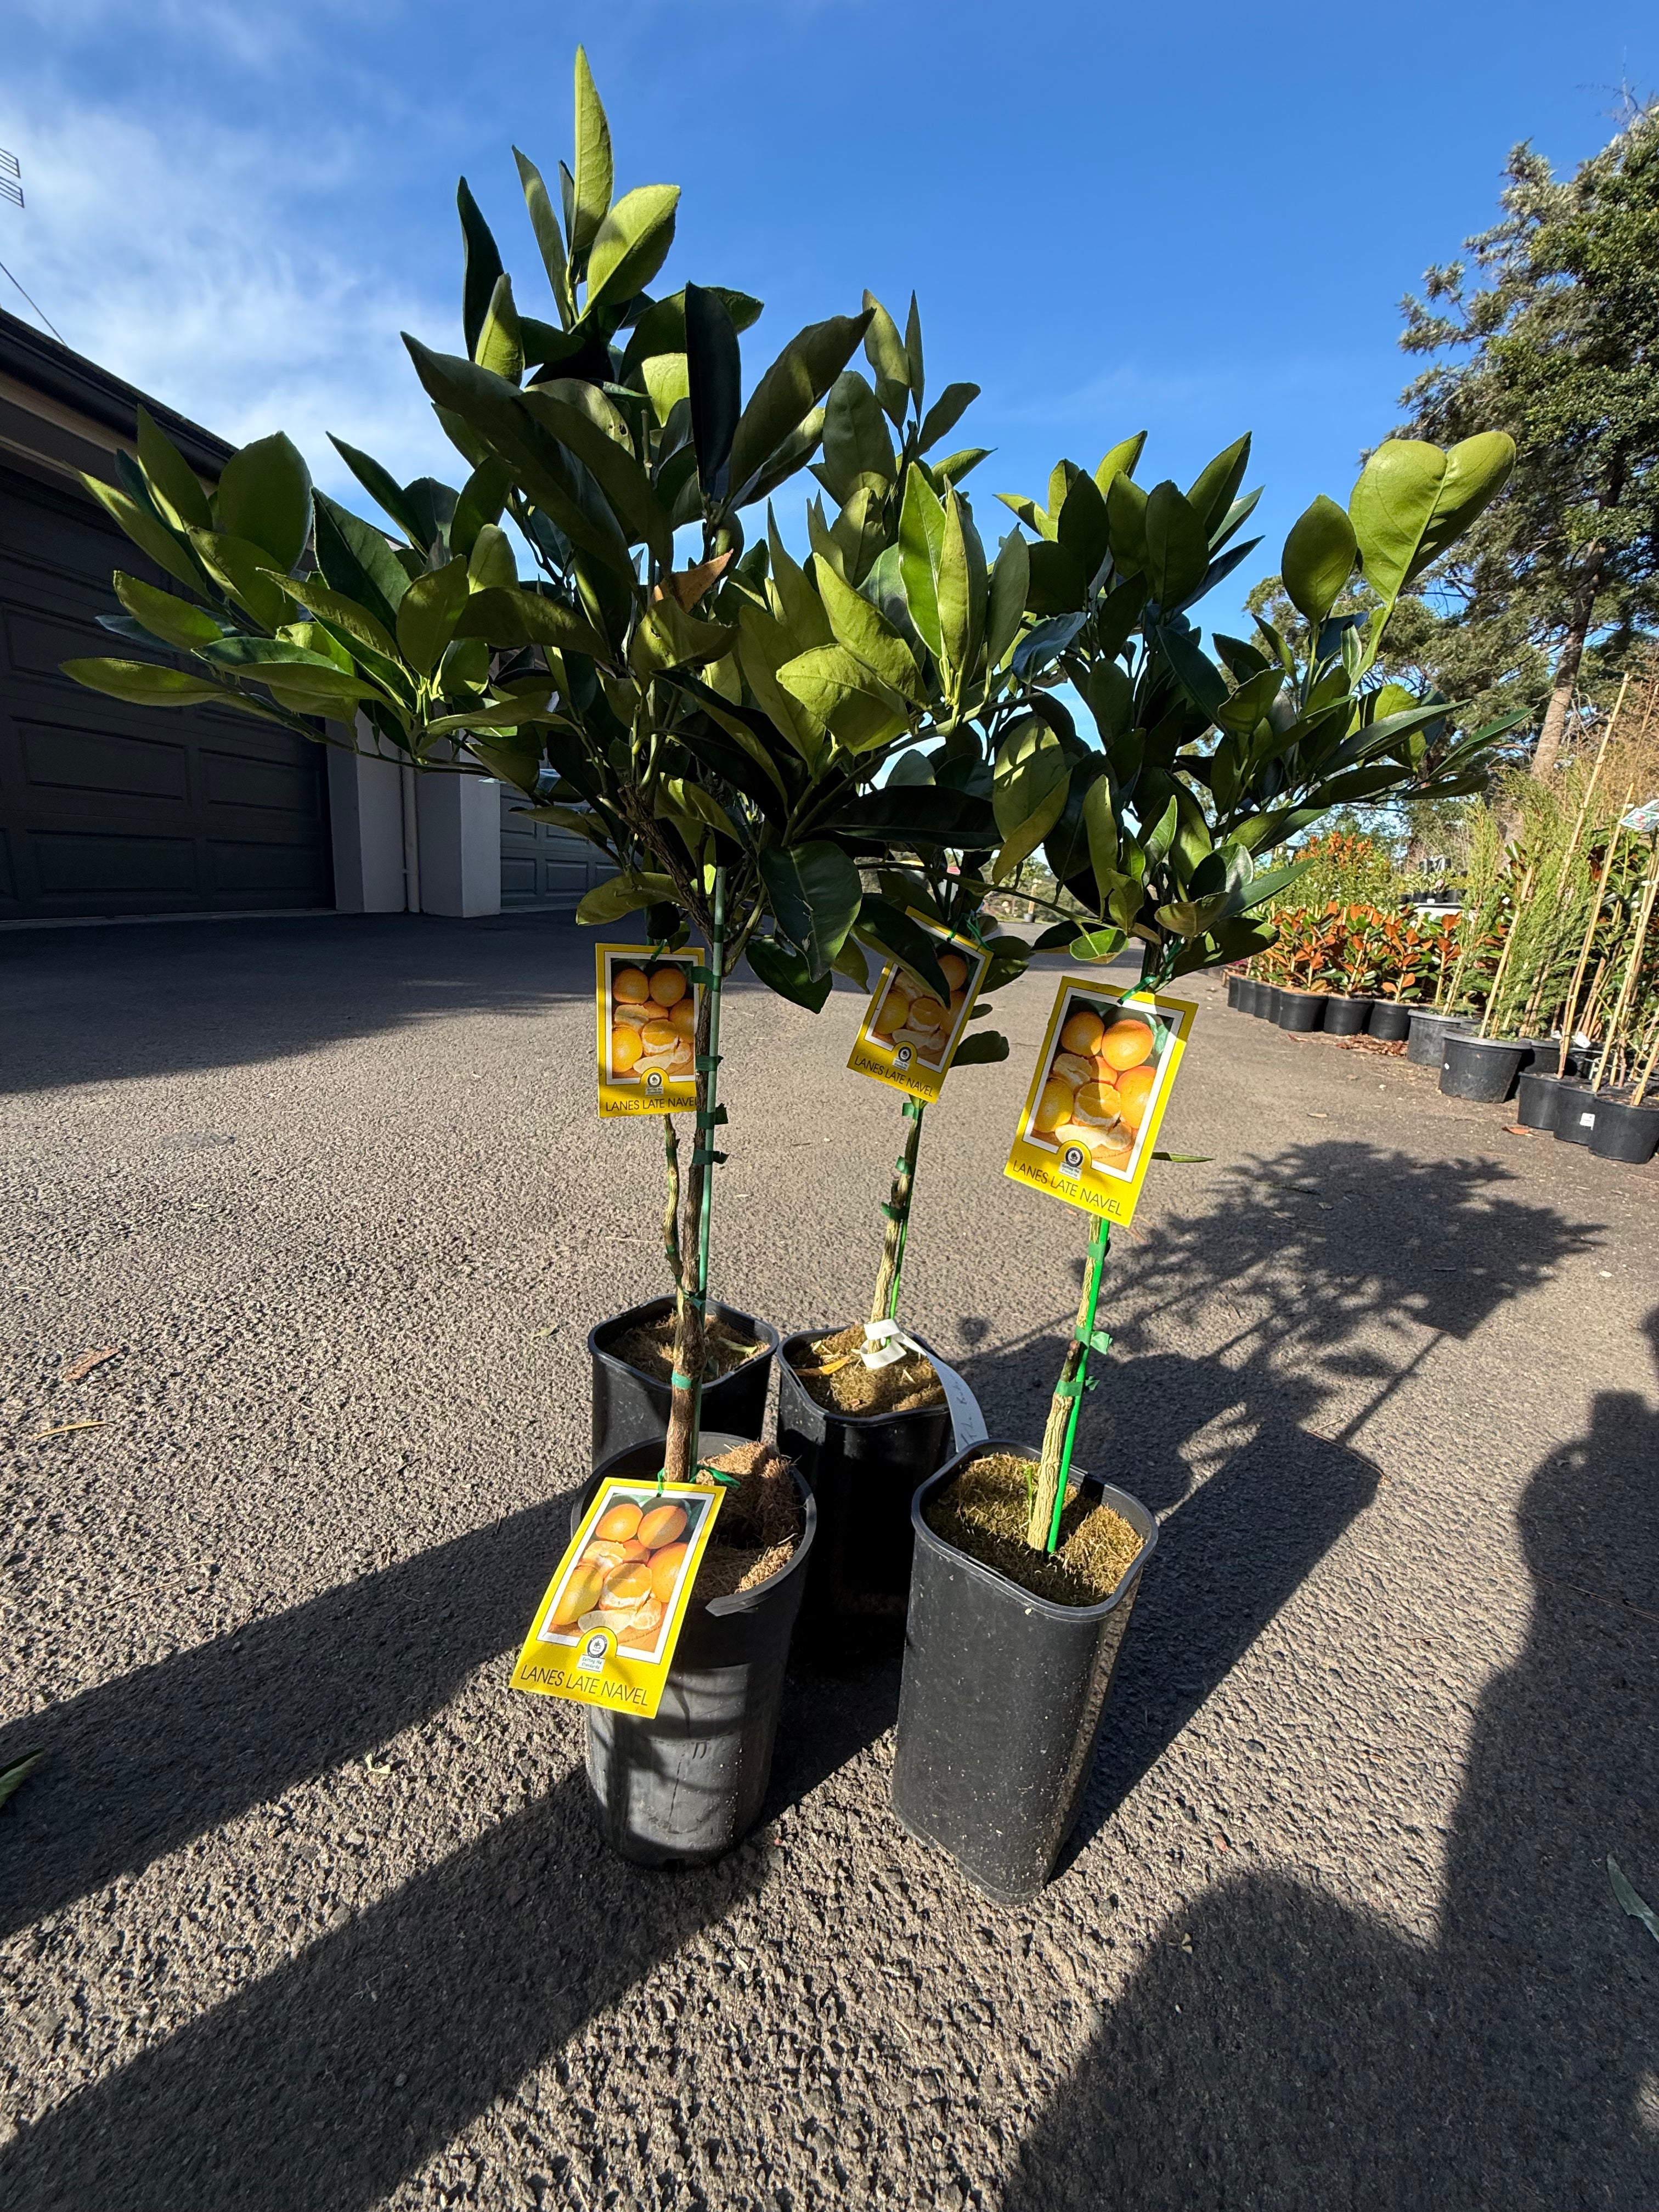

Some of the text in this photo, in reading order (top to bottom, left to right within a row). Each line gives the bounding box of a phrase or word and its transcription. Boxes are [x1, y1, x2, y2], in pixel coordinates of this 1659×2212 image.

[855, 1056, 884, 1075] LANES
[884, 1069, 906, 1085] LATE
[906, 1078, 933, 1097] NAVEL
[606, 1100, 640, 1111] LANES
[642, 1098, 665, 1109] LATE
[1013, 1160, 1121, 1216] LANES LATE NAVEL
[520, 1664, 647, 1706] LANES LATE NAVEL
